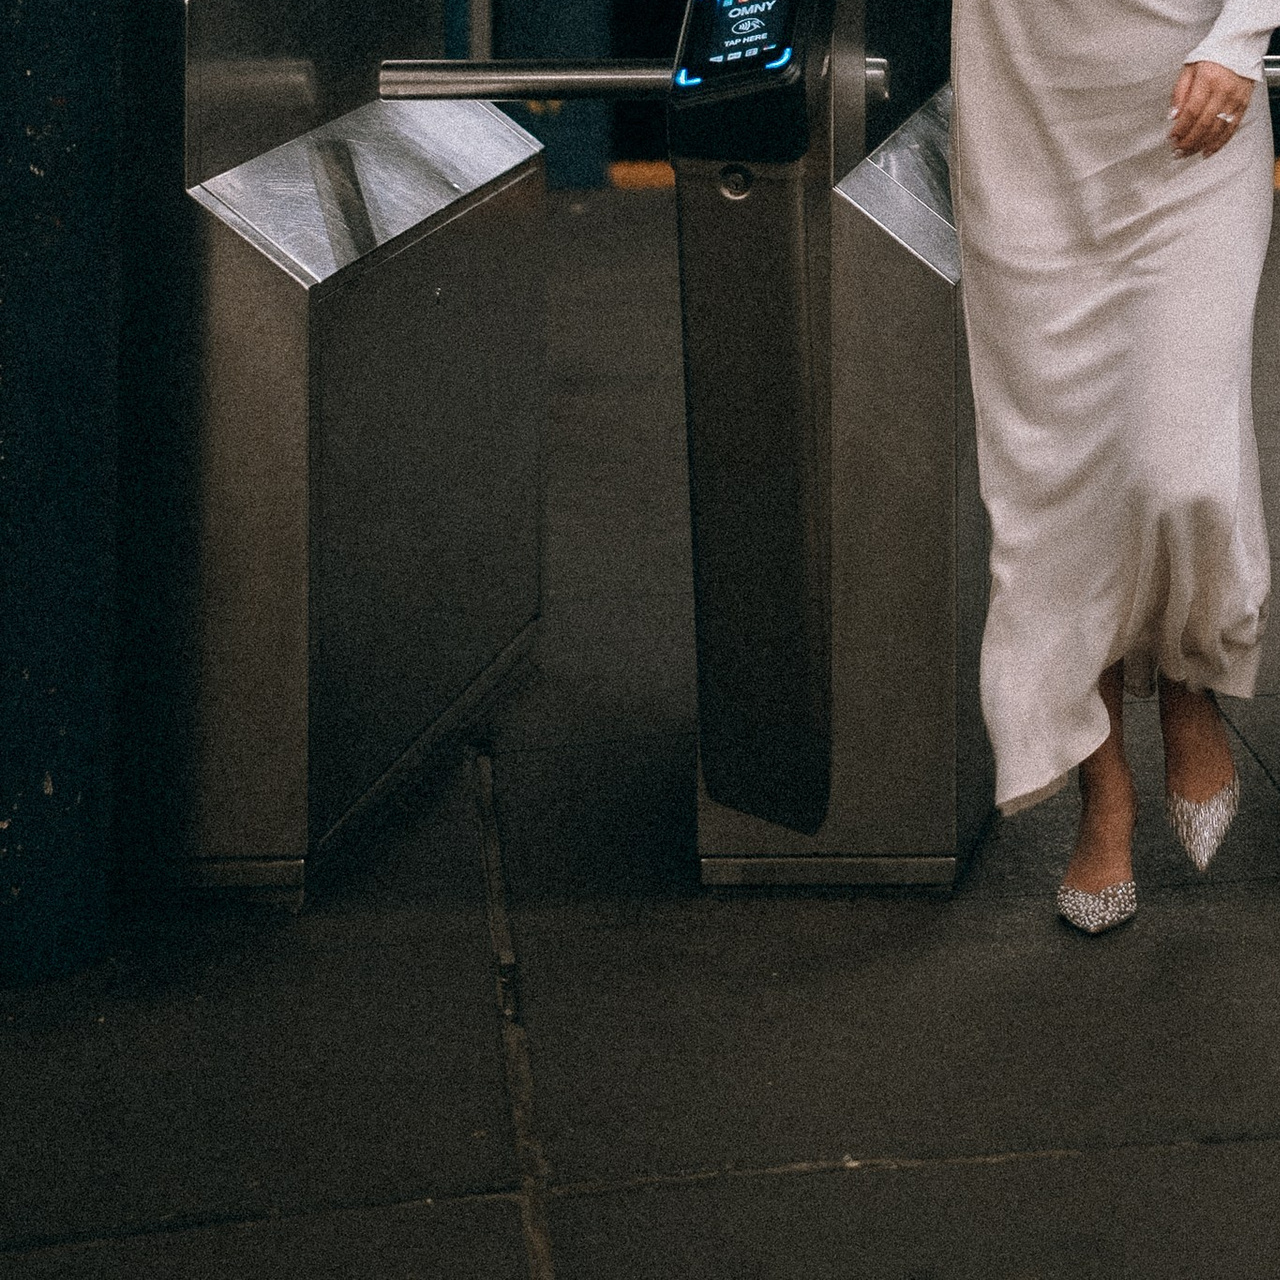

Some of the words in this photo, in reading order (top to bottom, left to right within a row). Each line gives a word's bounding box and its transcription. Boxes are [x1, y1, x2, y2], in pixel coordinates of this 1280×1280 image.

[727, 0, 777, 18] OMNY
[724, 38, 742, 47] TAP
[742, 32, 768, 44] HERE
